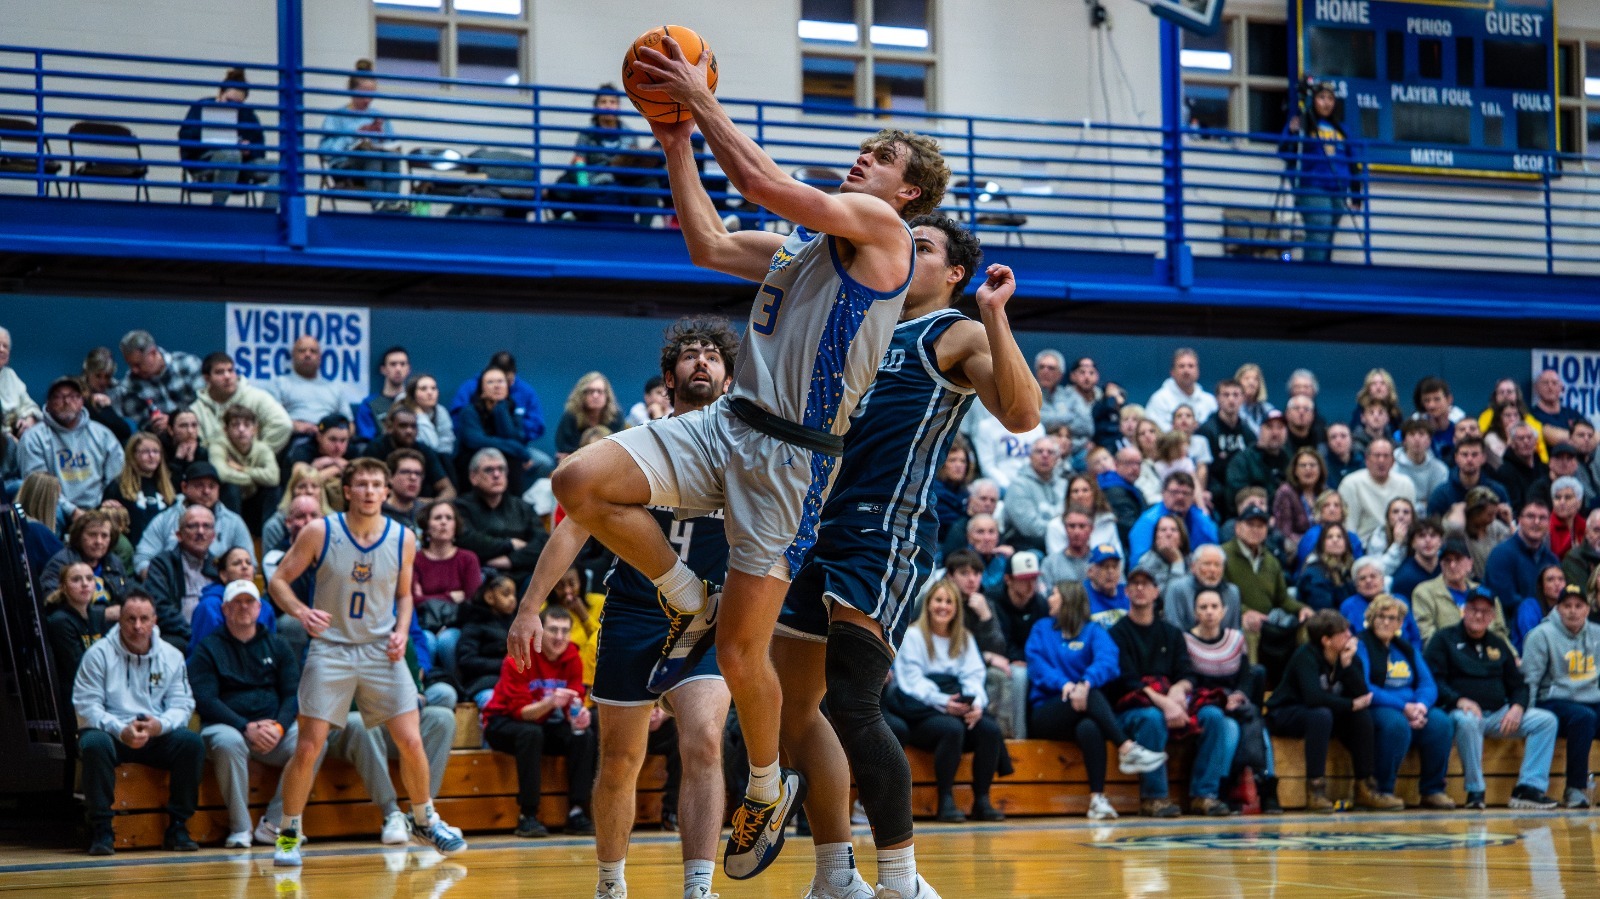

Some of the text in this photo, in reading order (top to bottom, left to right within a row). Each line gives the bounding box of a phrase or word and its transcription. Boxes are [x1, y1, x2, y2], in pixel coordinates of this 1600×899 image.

[1315, 0, 1370, 24] HOME
[1485, 10, 1544, 37] GUEST
[1406, 17, 1452, 37] PERIOD
[1391, 84, 1473, 107] PLAYER FOUL
[1512, 92, 1552, 112] FOULS
[1410, 148, 1454, 166] MATCH
[752, 283, 785, 337] 3
[234, 309, 361, 346] VISITORS
[235, 346, 360, 383] SECON
[669, 520, 694, 562] 4
[349, 591, 366, 619] 0
